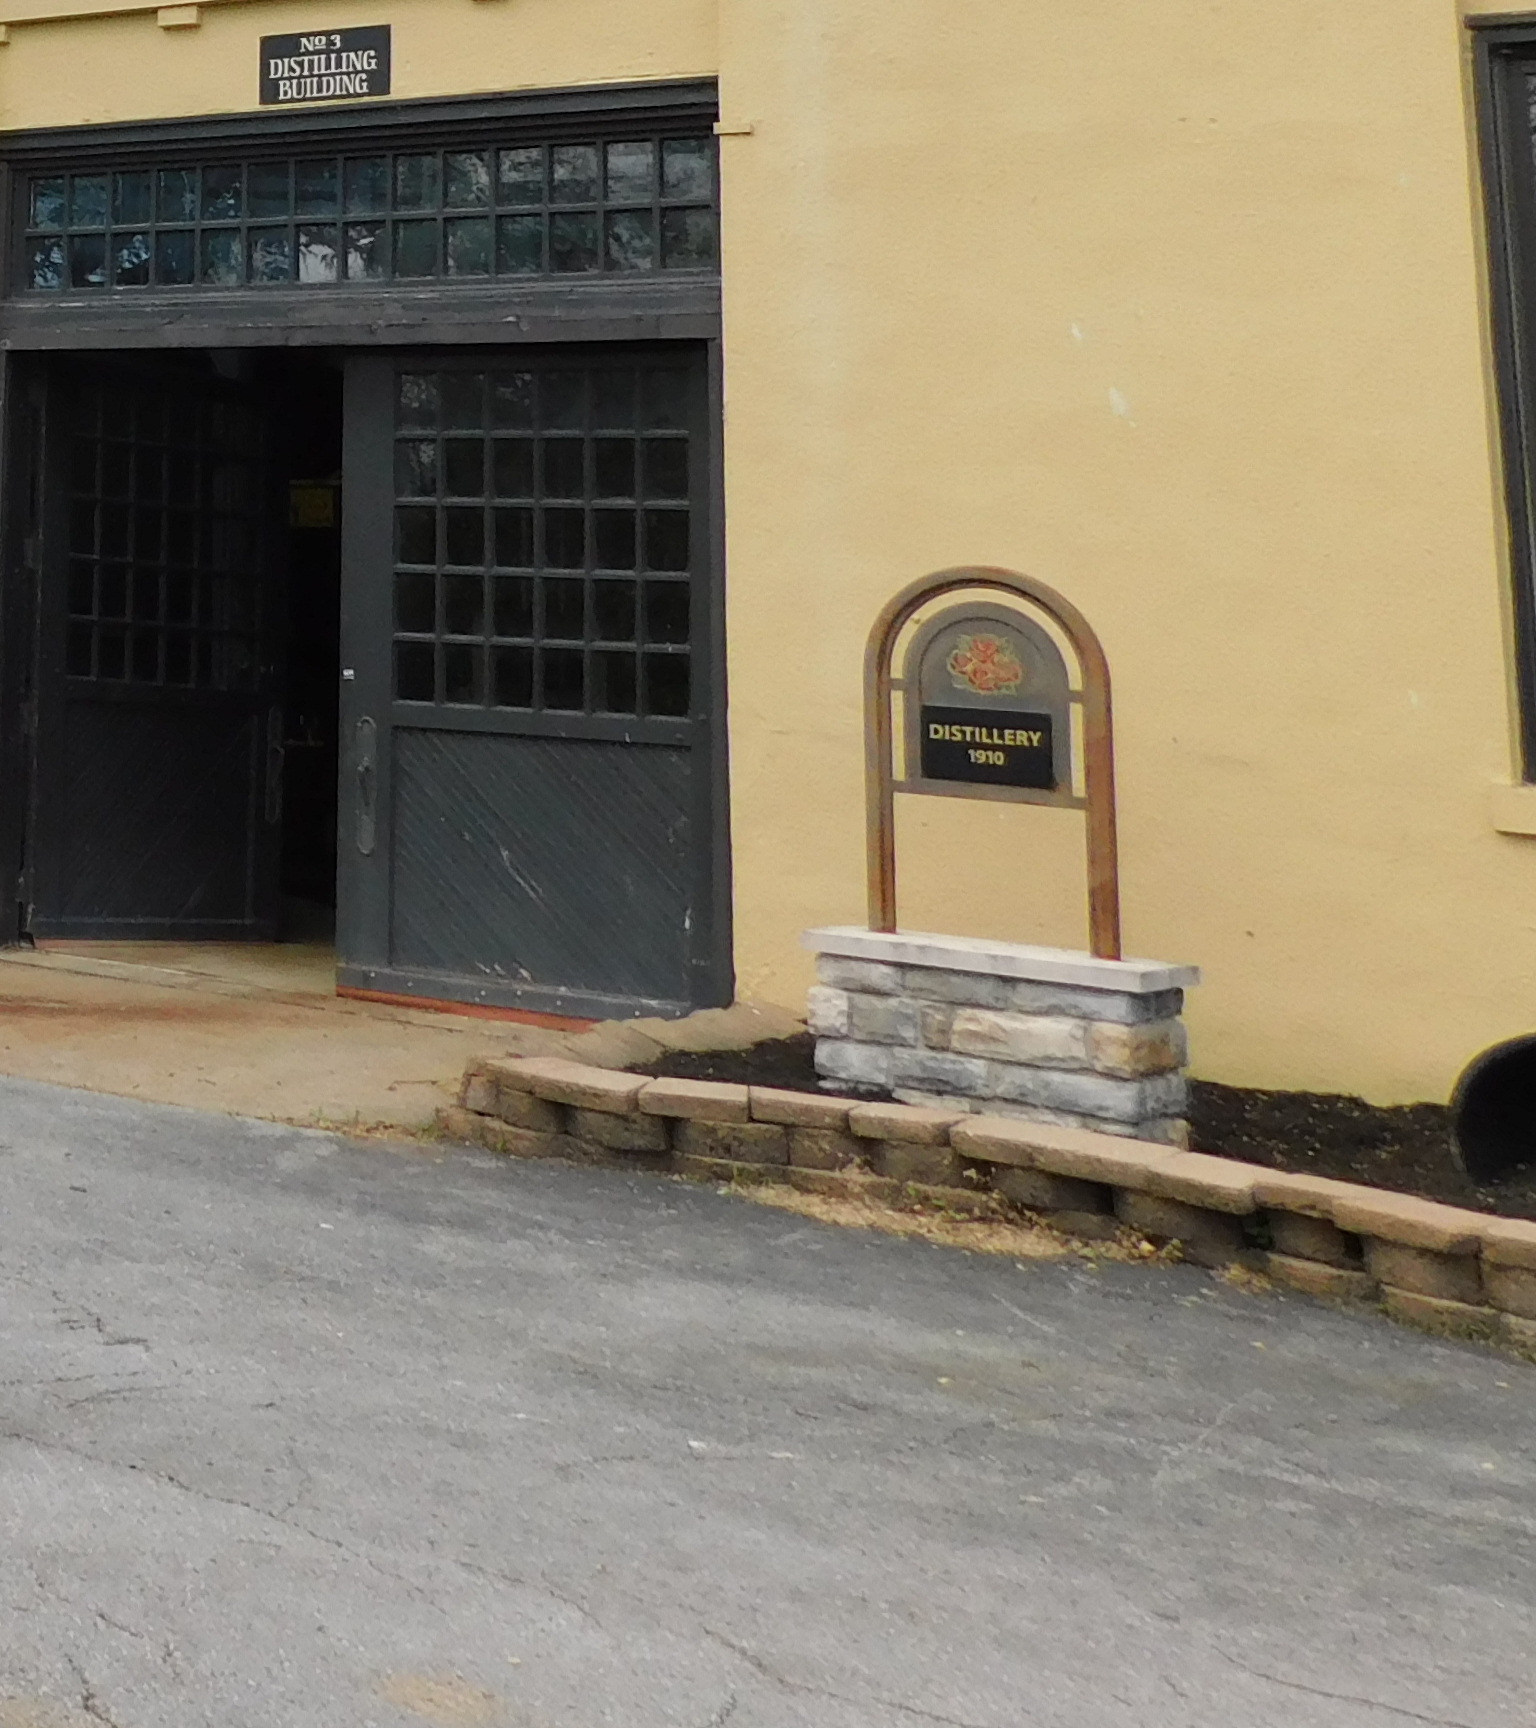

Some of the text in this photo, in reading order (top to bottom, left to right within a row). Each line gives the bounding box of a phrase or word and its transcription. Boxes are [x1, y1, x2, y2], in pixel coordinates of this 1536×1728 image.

[330, 35, 341, 49] 3
[269, 50, 377, 79] DISTILLING
[278, 72, 370, 101] BUILDING
[929, 723, 1042, 747] DISTILLERY
[968, 749, 1005, 765] 1910
